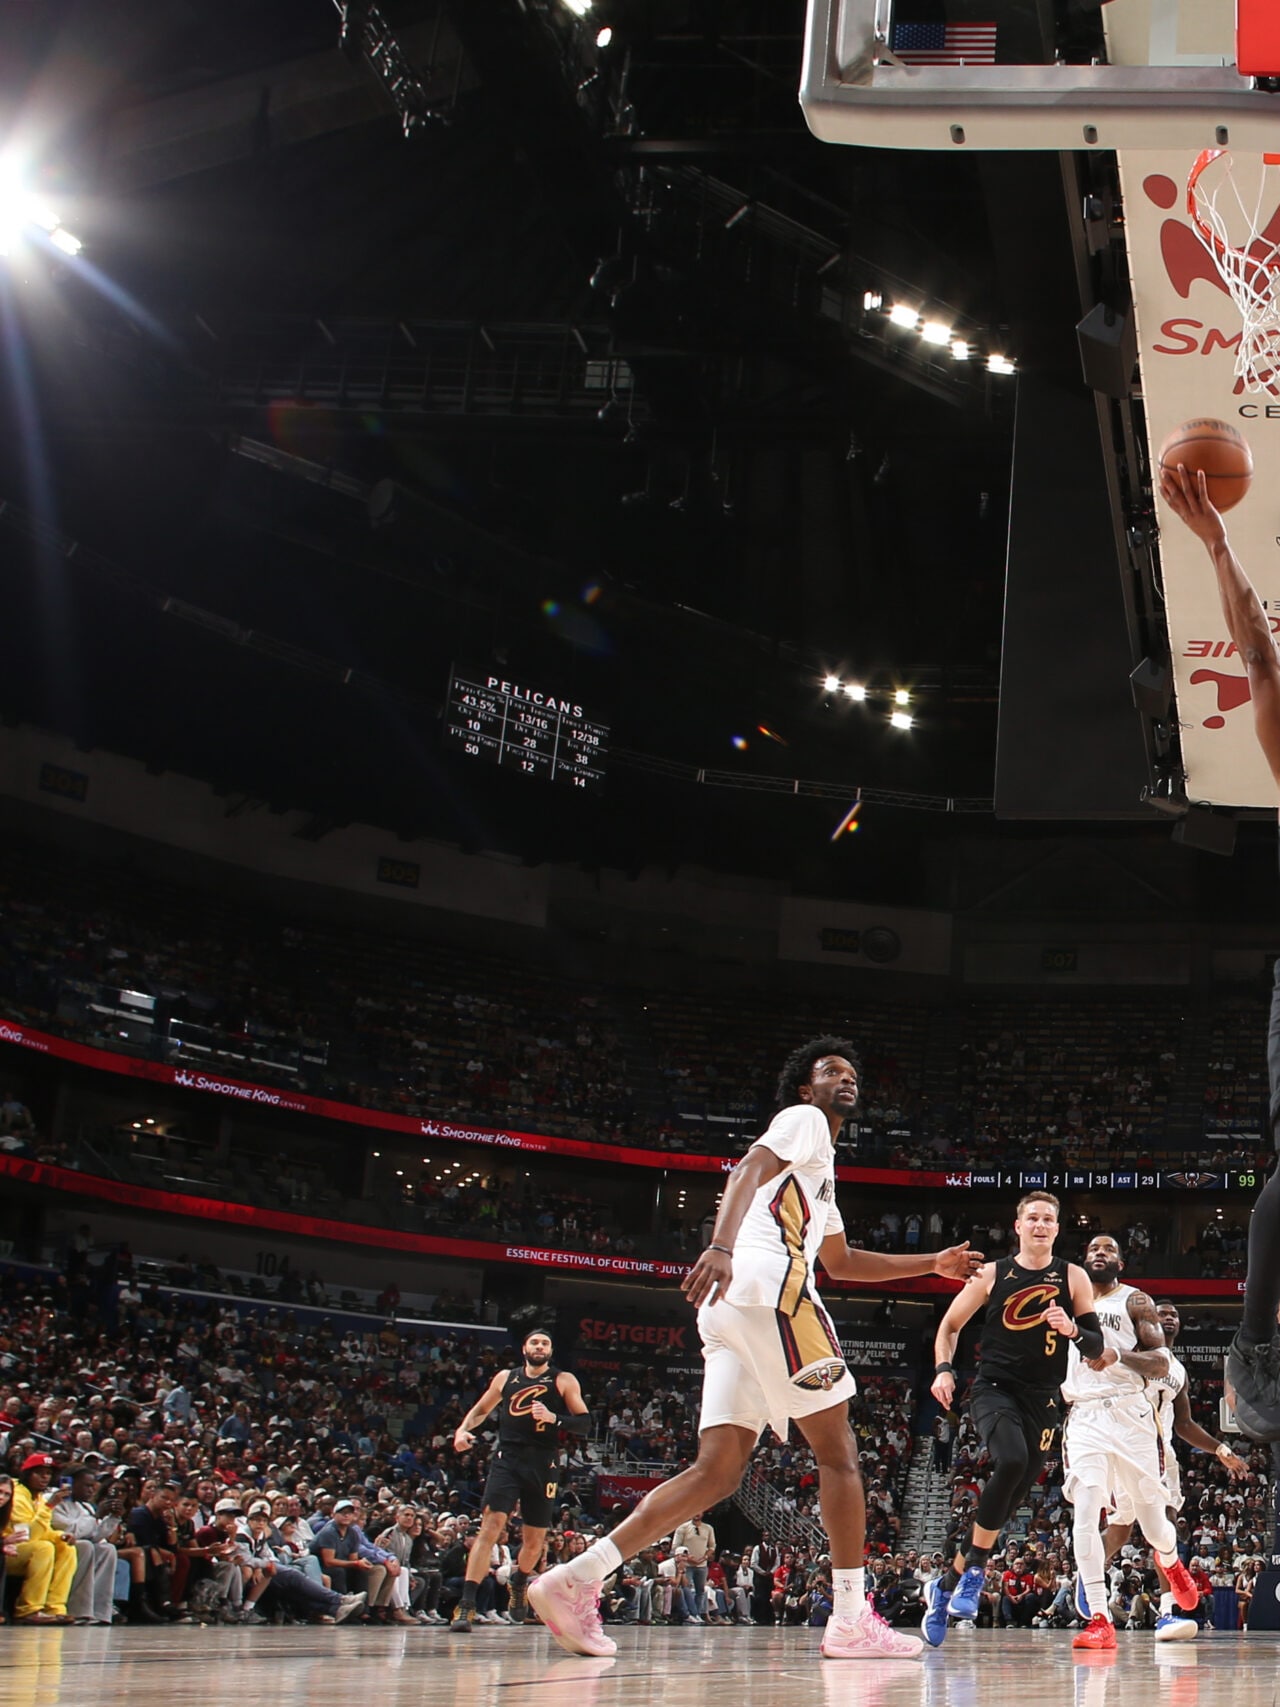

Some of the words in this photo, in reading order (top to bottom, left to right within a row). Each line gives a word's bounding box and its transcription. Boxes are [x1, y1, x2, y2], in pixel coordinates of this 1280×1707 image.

[462, 695, 497, 713] 43.5%
[487, 677, 583, 718] PELICANS
[467, 720, 480, 731] 10
[520, 713, 548, 729] 13/16
[523, 737, 537, 749] 28
[572, 730, 599, 746] 12/38
[465, 743, 479, 755] 50
[521, 761, 535, 772] 12
[575, 753, 588, 765] 38
[573, 777, 585, 787] 14
[380, 864, 417, 884] 305
[1044, 953, 1075, 968] 307
[195, 1077, 252, 1098] SMOOTHIE
[441, 1126, 494, 1143] SMOOTHIE
[1005, 1176, 1012, 1184] 4
[1053, 1176, 1059, 1184] 2
[1095, 1175, 1108, 1184] 38
[1117, 1176, 1131, 1184] AST
[1141, 1175, 1154, 1185] 29
[1239, 1174, 1255, 1187] 99
[506, 1248, 549, 1261] ESSENCE
[551, 1253, 596, 1266] FESTIVAL
[597, 1258, 611, 1267] OF
[612, 1260, 654, 1272] CULTURE
[660, 1264, 684, 1274] JULY
[579, 1319, 687, 1348] SEATGEEK
[865, 1341, 896, 1350] PARTNER
[897, 1342, 906, 1350] OF
[1045, 1331, 1057, 1356] 5
[1186, 1346, 1220, 1354] TICKETING
[1157, 1389, 1165, 1412] 1
